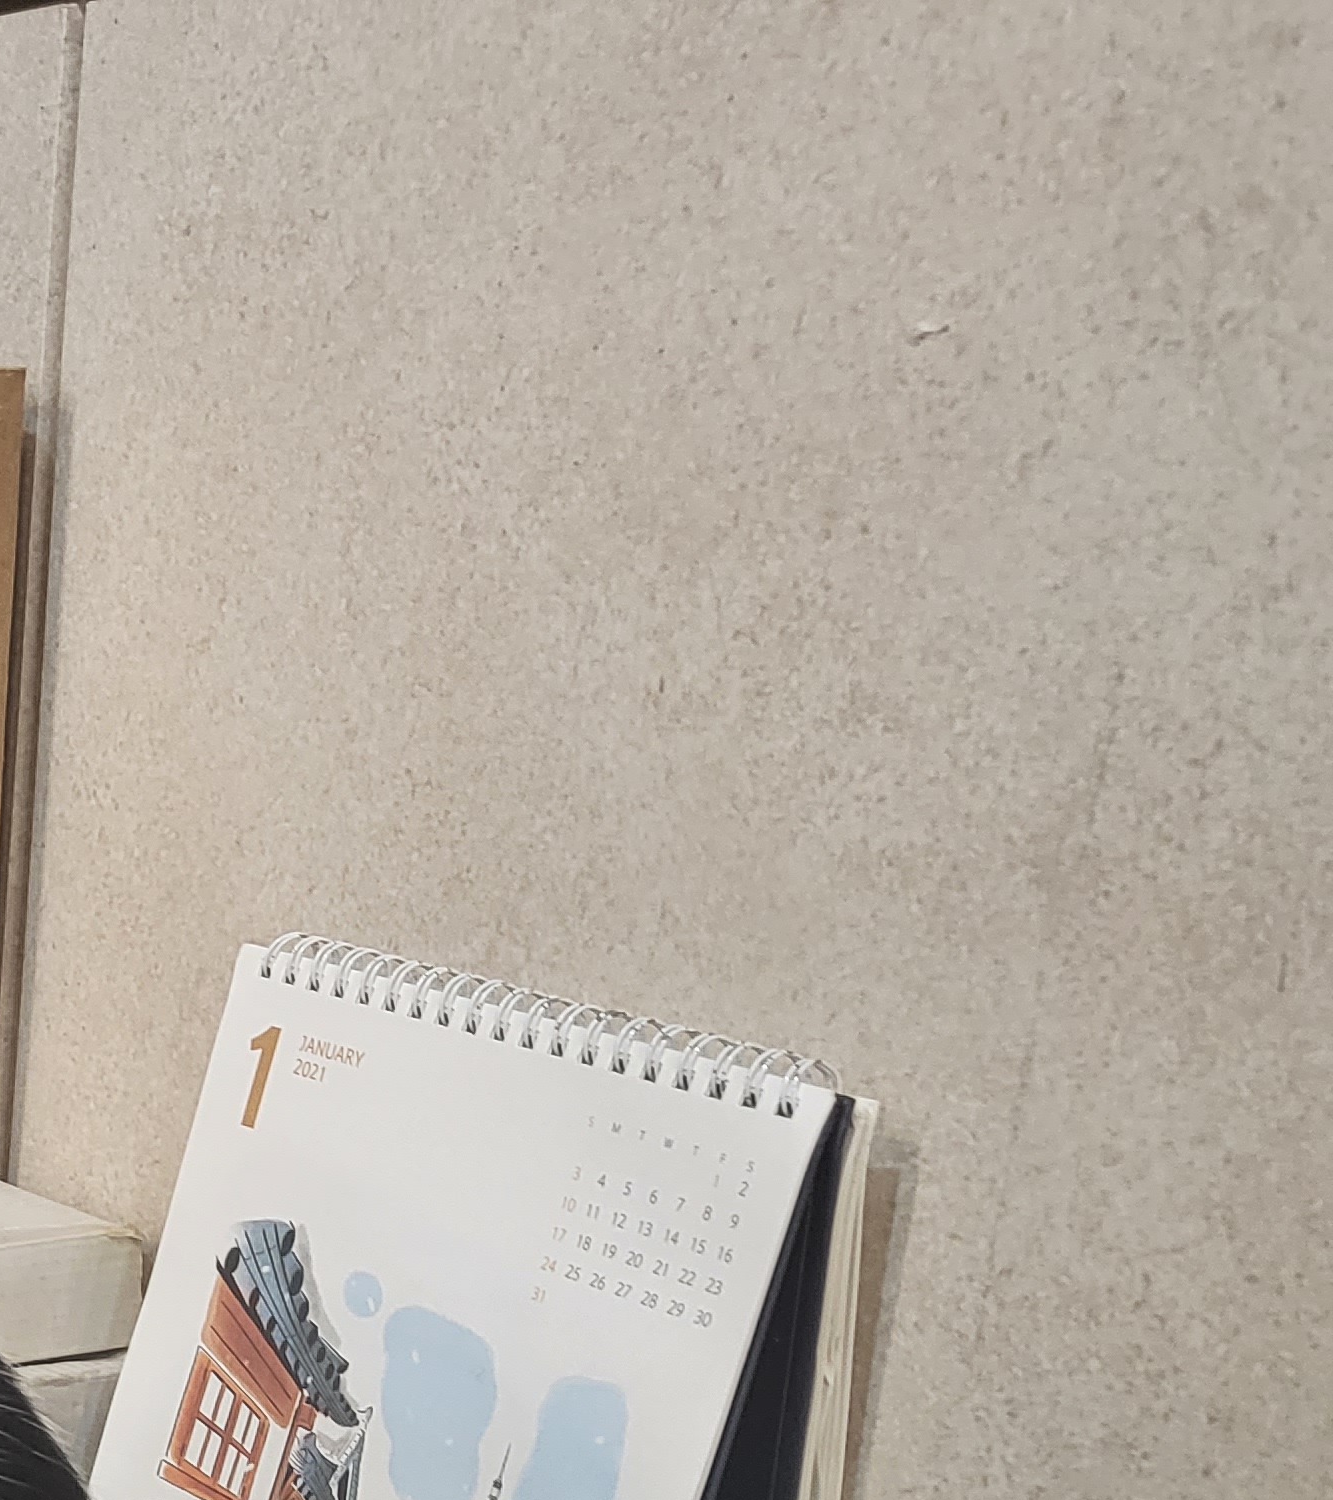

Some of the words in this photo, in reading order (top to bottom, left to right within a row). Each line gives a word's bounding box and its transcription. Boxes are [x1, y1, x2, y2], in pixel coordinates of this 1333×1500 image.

[293, 1058, 326, 1082] 2021
[299, 1035, 365, 1068] JANUARY
[241, 1026, 281, 1128] 1
[738, 1181, 749, 1197] 2
[746, 1160, 755, 1172] S
[573, 1166, 581, 1181] 3
[597, 1174, 606, 1188] 4
[623, 1181, 632, 1196] 5
[649, 1189, 658, 1204] 6
[676, 1197, 686, 1212] 7
[703, 1205, 713, 1221] 8
[729, 1214, 739, 1228] 9
[562, 1196, 577, 1213] 10
[587, 1204, 600, 1220] 11
[613, 1212, 627, 1229] 12
[638, 1220, 653, 1237] 13
[665, 1229, 679, 1245] 14
[691, 1237, 707, 1255] 15
[718, 1246, 733, 1264] 16
[553, 1227, 567, 1242] 17
[577, 1234, 592, 1251] 18
[602, 1243, 617, 1259] 19
[625, 1251, 644, 1268] 20
[653, 1259, 669, 1277] 21
[677, 1268, 697, 1286] 22
[705, 1277, 723, 1295] 23
[532, 1286, 546, 1302] 31
[541, 1256, 557, 1272] 24
[565, 1264, 581, 1281] 25
[589, 1273, 606, 1290] 26
[615, 1281, 633, 1298] 27
[640, 1291, 659, 1309] 28
[666, 1299, 685, 1317] 29
[693, 1310, 712, 1328] 30
